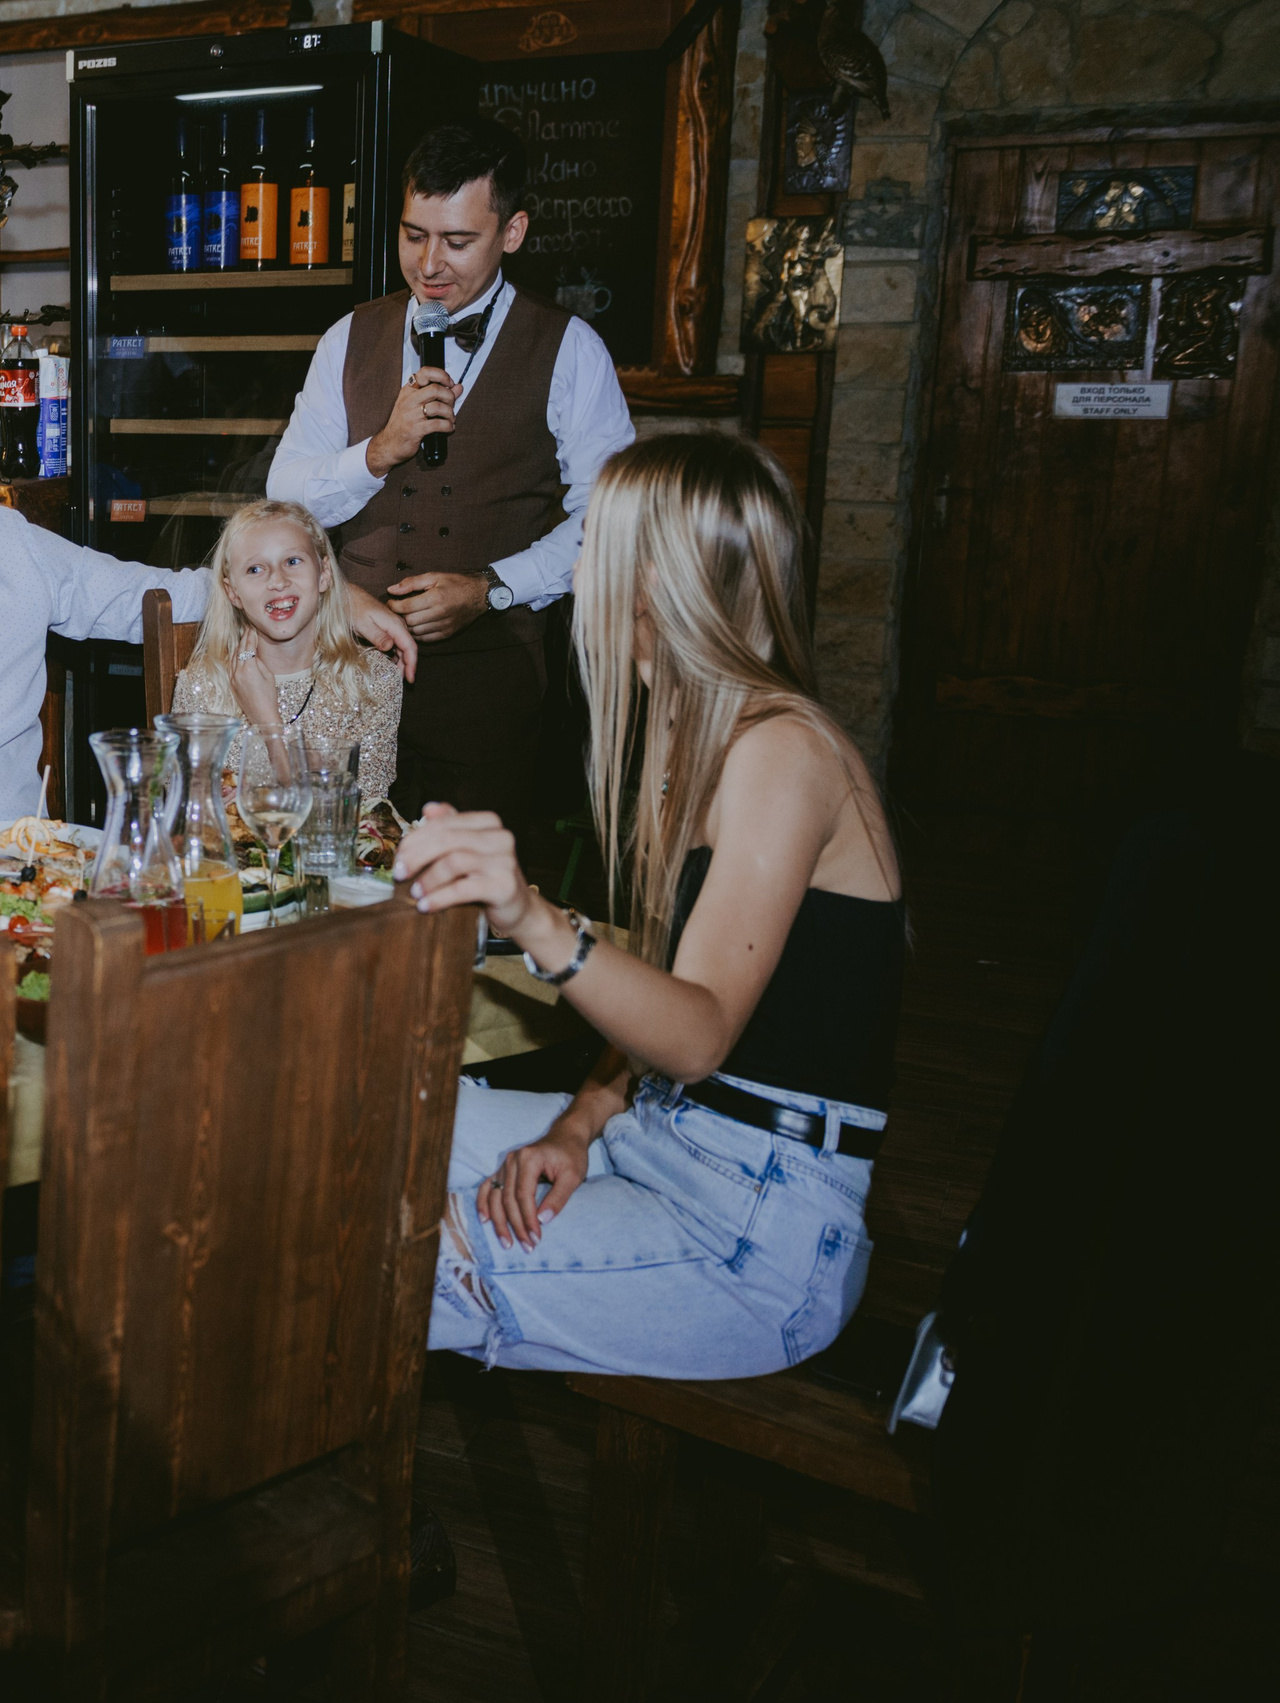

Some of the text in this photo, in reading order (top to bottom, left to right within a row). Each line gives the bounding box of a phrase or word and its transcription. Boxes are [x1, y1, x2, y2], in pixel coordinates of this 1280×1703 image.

[78, 57, 117, 70] POZIS
[478, 77, 597, 108] апучино
[204, 244, 225, 253] PATRE
[112, 338, 143, 348] PATRET
[1071, 396, 1091, 404] ДЛЯ
[113, 502, 143, 512] PATRET
